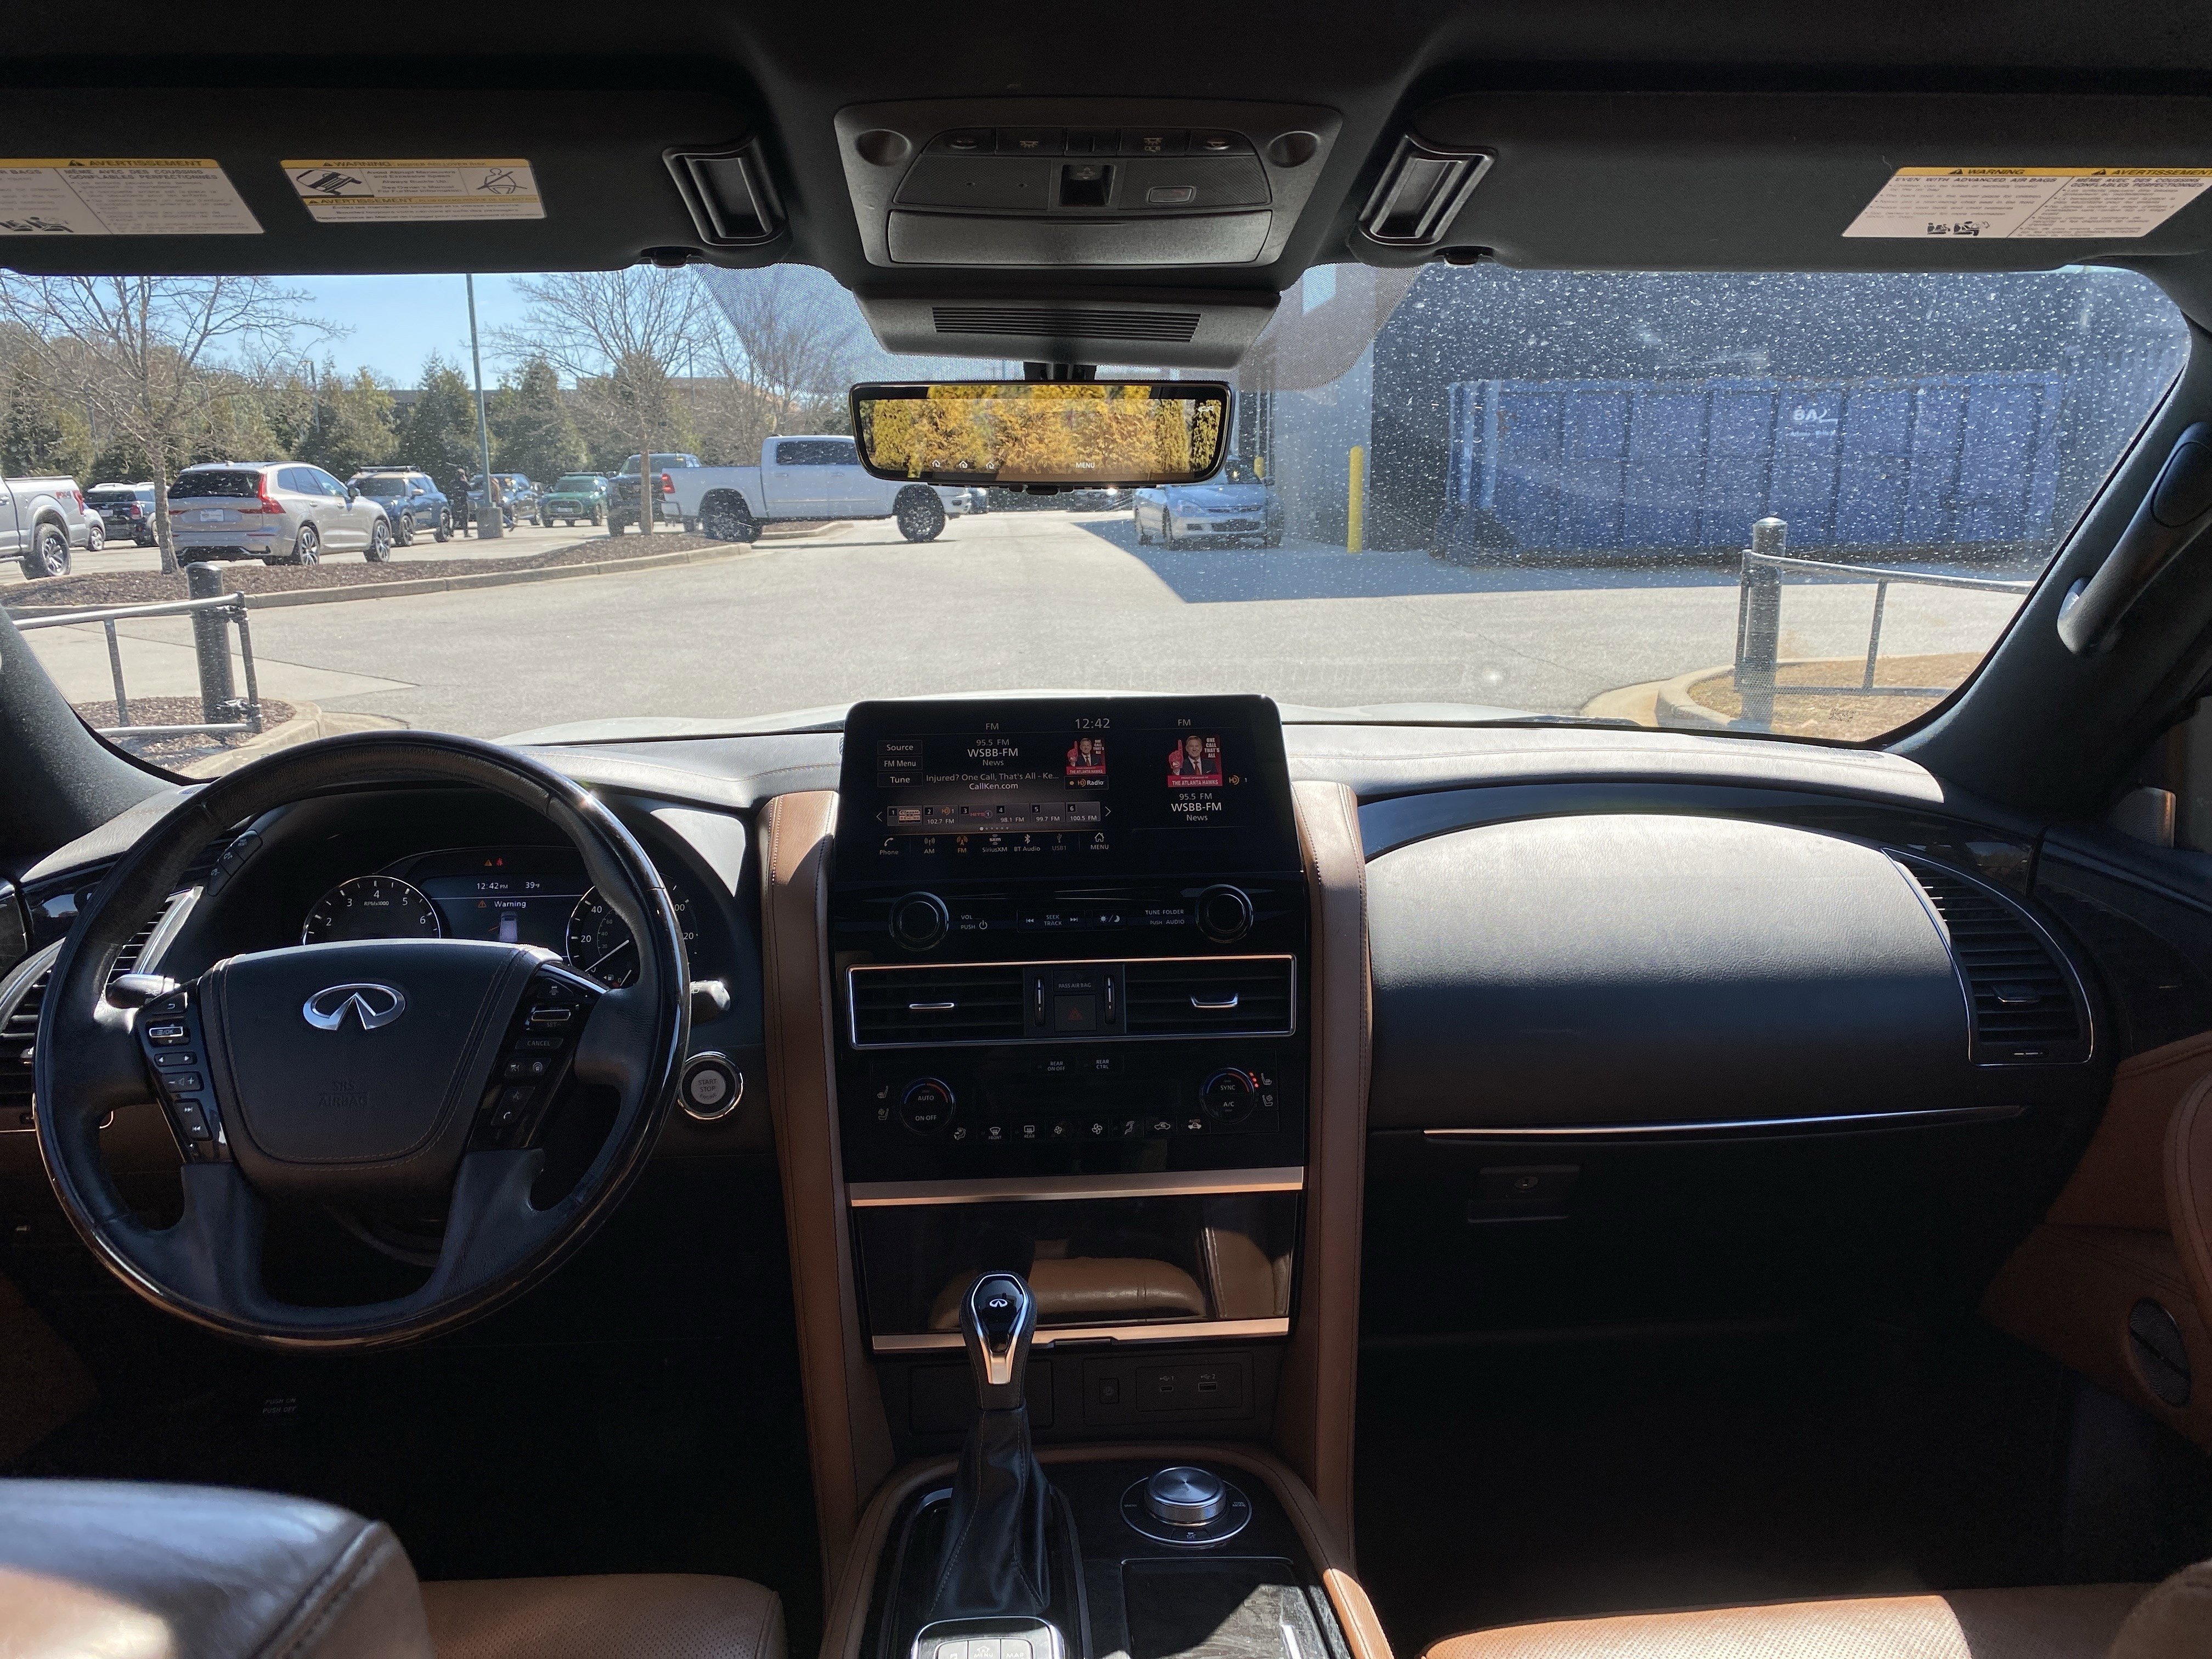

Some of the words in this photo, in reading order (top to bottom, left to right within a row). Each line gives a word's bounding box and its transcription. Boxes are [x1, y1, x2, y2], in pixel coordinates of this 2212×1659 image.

[1075, 718, 1111, 729] 12:42
[967, 748, 1019, 758] WSBB-FM
[926, 774, 960, 783] Injured?
[980, 773, 997, 782] Call,
[969, 782, 1019, 790] CallKen.com
[1171, 802, 1222, 812] WSBB-FM
[373, 889, 380, 899] 4
[346, 898, 353, 907] 3
[402, 896, 408, 906] 5
[494, 900, 526, 909] Warning
[591, 906, 602, 914] 40
[674, 904, 685, 912] 00
[325, 917, 332, 927] 2
[419, 915, 426, 924] 6
[580, 935, 592, 943] 20
[684, 932, 694, 940] 20
